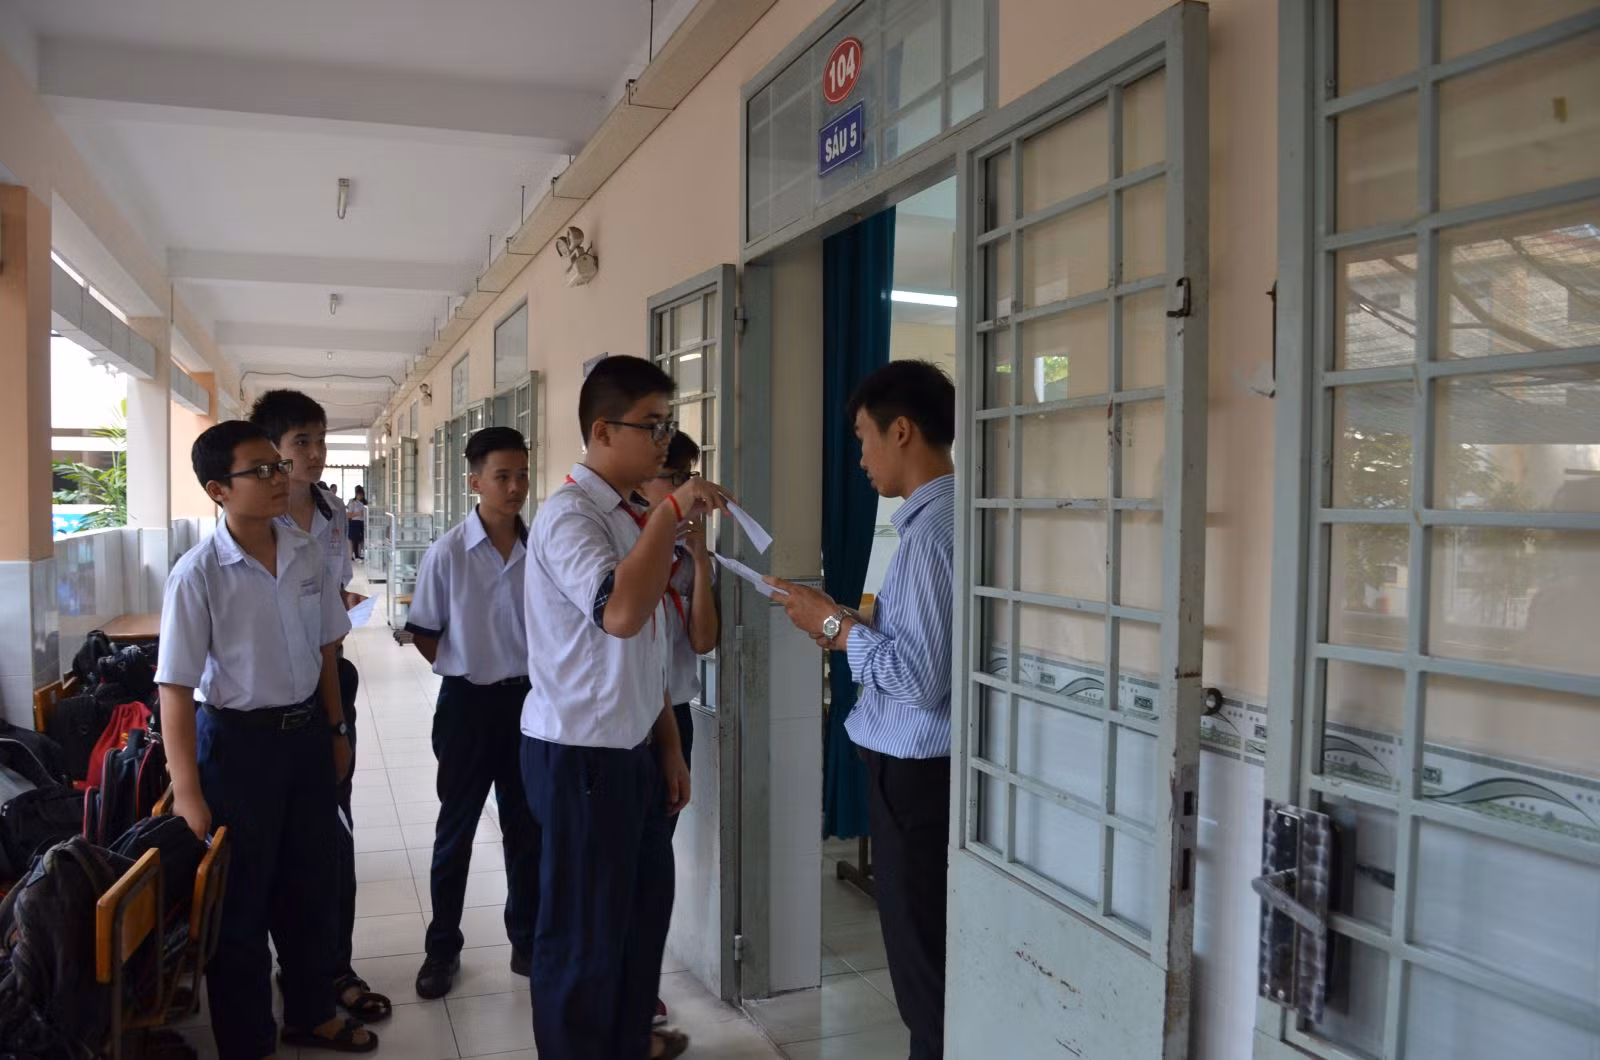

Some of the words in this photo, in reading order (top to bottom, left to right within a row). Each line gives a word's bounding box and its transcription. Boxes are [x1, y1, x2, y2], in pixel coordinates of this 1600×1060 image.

[829, 46, 856, 93] 104
[825, 126, 848, 162] SÁU
[850, 121, 857, 148] 5
